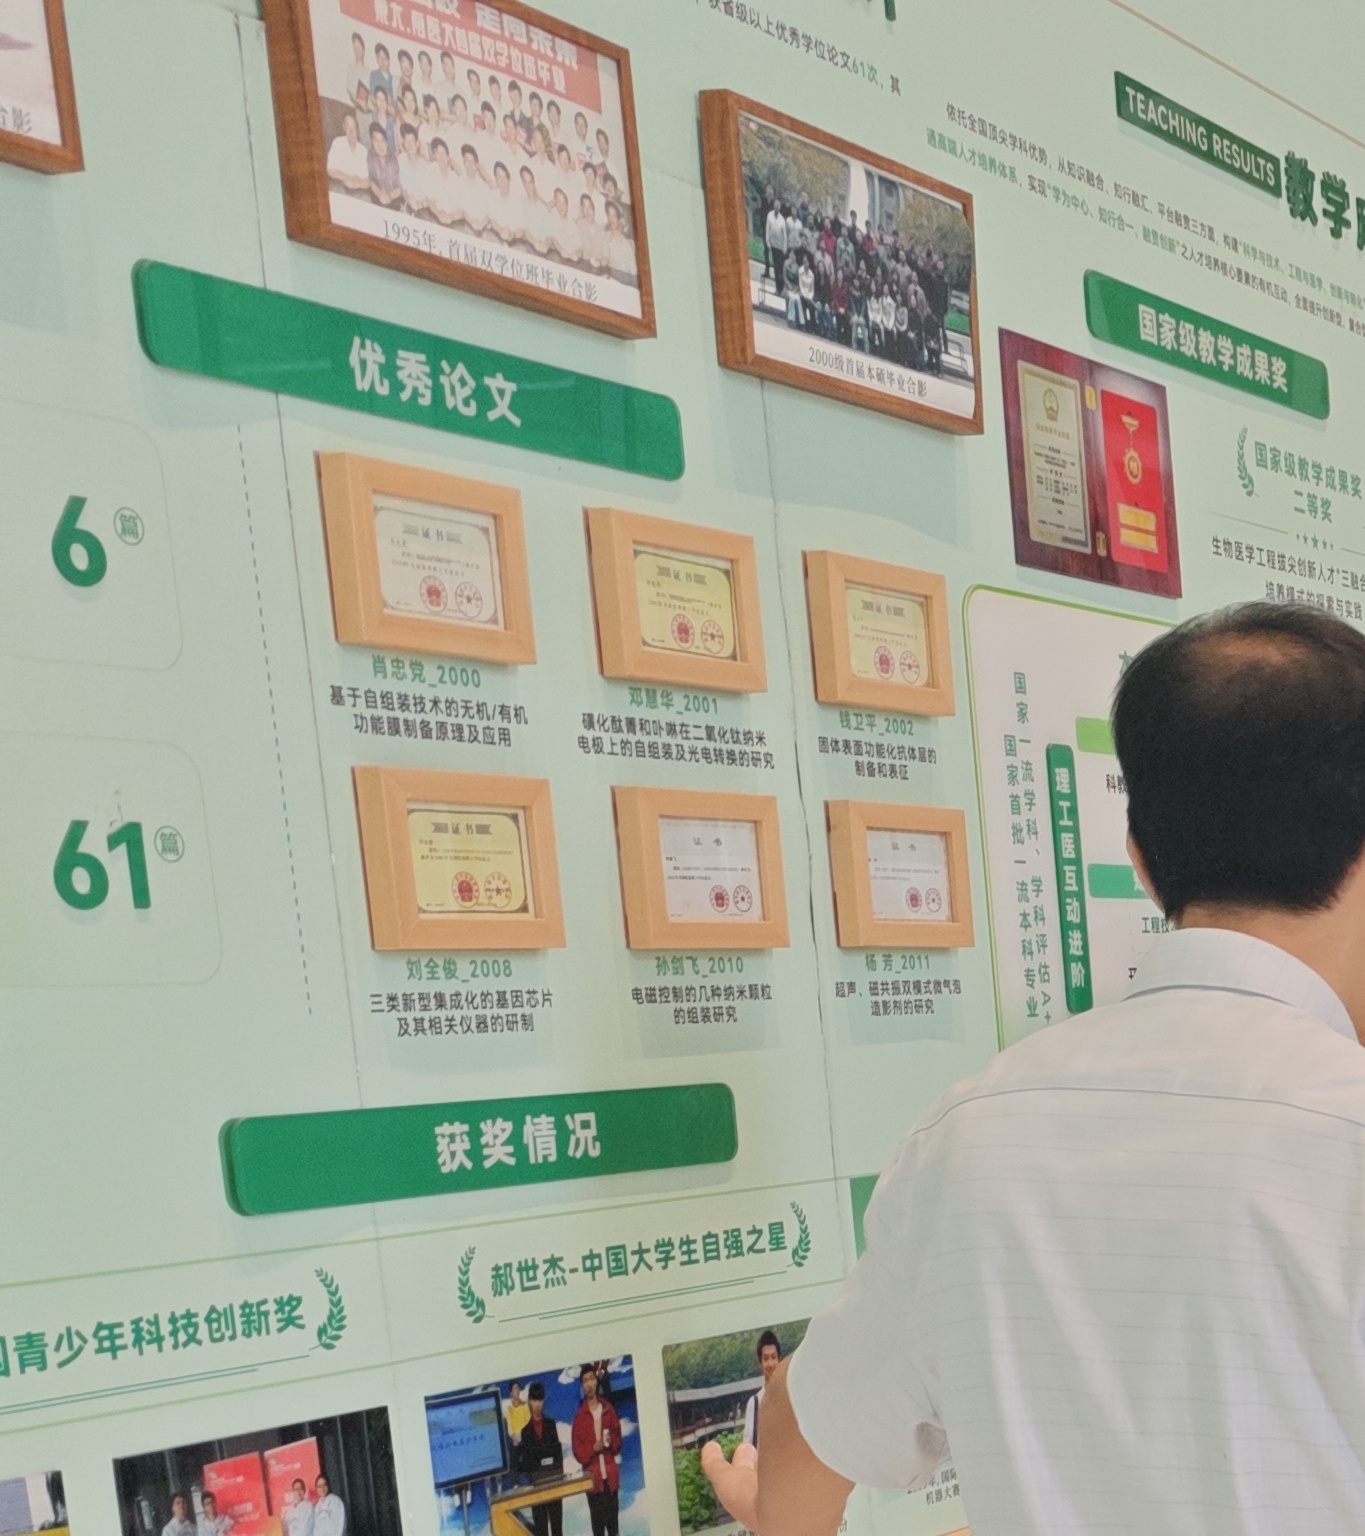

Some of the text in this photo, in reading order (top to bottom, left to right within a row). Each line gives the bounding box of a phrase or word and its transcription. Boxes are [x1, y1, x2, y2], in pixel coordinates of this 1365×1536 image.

[1125, 86, 1276, 187] TEACHING RESULTS
[1138, 302, 1289, 393] 国家级教学成果奖
[349, 334, 523, 428] 优秀论文
[1254, 440, 1363, 500] 国家级教学成果奖
[1293, 489, 1333, 524] 二等奖
[52, 495, 108, 588] 6
[372, 654, 482, 688] 肖忠党_2000
[330, 684, 529, 726] 基于自组装技术的无机/有机
[628, 685, 719, 715] 邓慧华_2001
[353, 712, 513, 747] 功能膜制备原理及应用
[838, 710, 914, 736] 钱卫平_2002
[577, 735, 775, 770] 电极上的自组装及光电转换的研究
[818, 736, 937, 764] 固体表面功能化抗体层的
[854, 758, 909, 781] 制备和表征
[53, 819, 152, 911] 61
[1055, 767, 1086, 988] 理工医互动进阶
[405, 957, 513, 983] 刘全俊_2008
[655, 955, 744, 979] 孙剑飞_2010
[370, 990, 554, 1013] 三类新型集成化的基因芯片
[631, 983, 772, 1003] 电磁控制的几种纳米颗粒
[870, 998, 935, 1017] 造影剂的研究
[397, 1011, 535, 1038] 及其相关仪器的研制
[673, 1004, 738, 1026] 的组装研究
[434, 1110, 601, 1174] 获奖情况
[490, 1220, 789, 1299] 郝世杰-中国大学生自强之星
